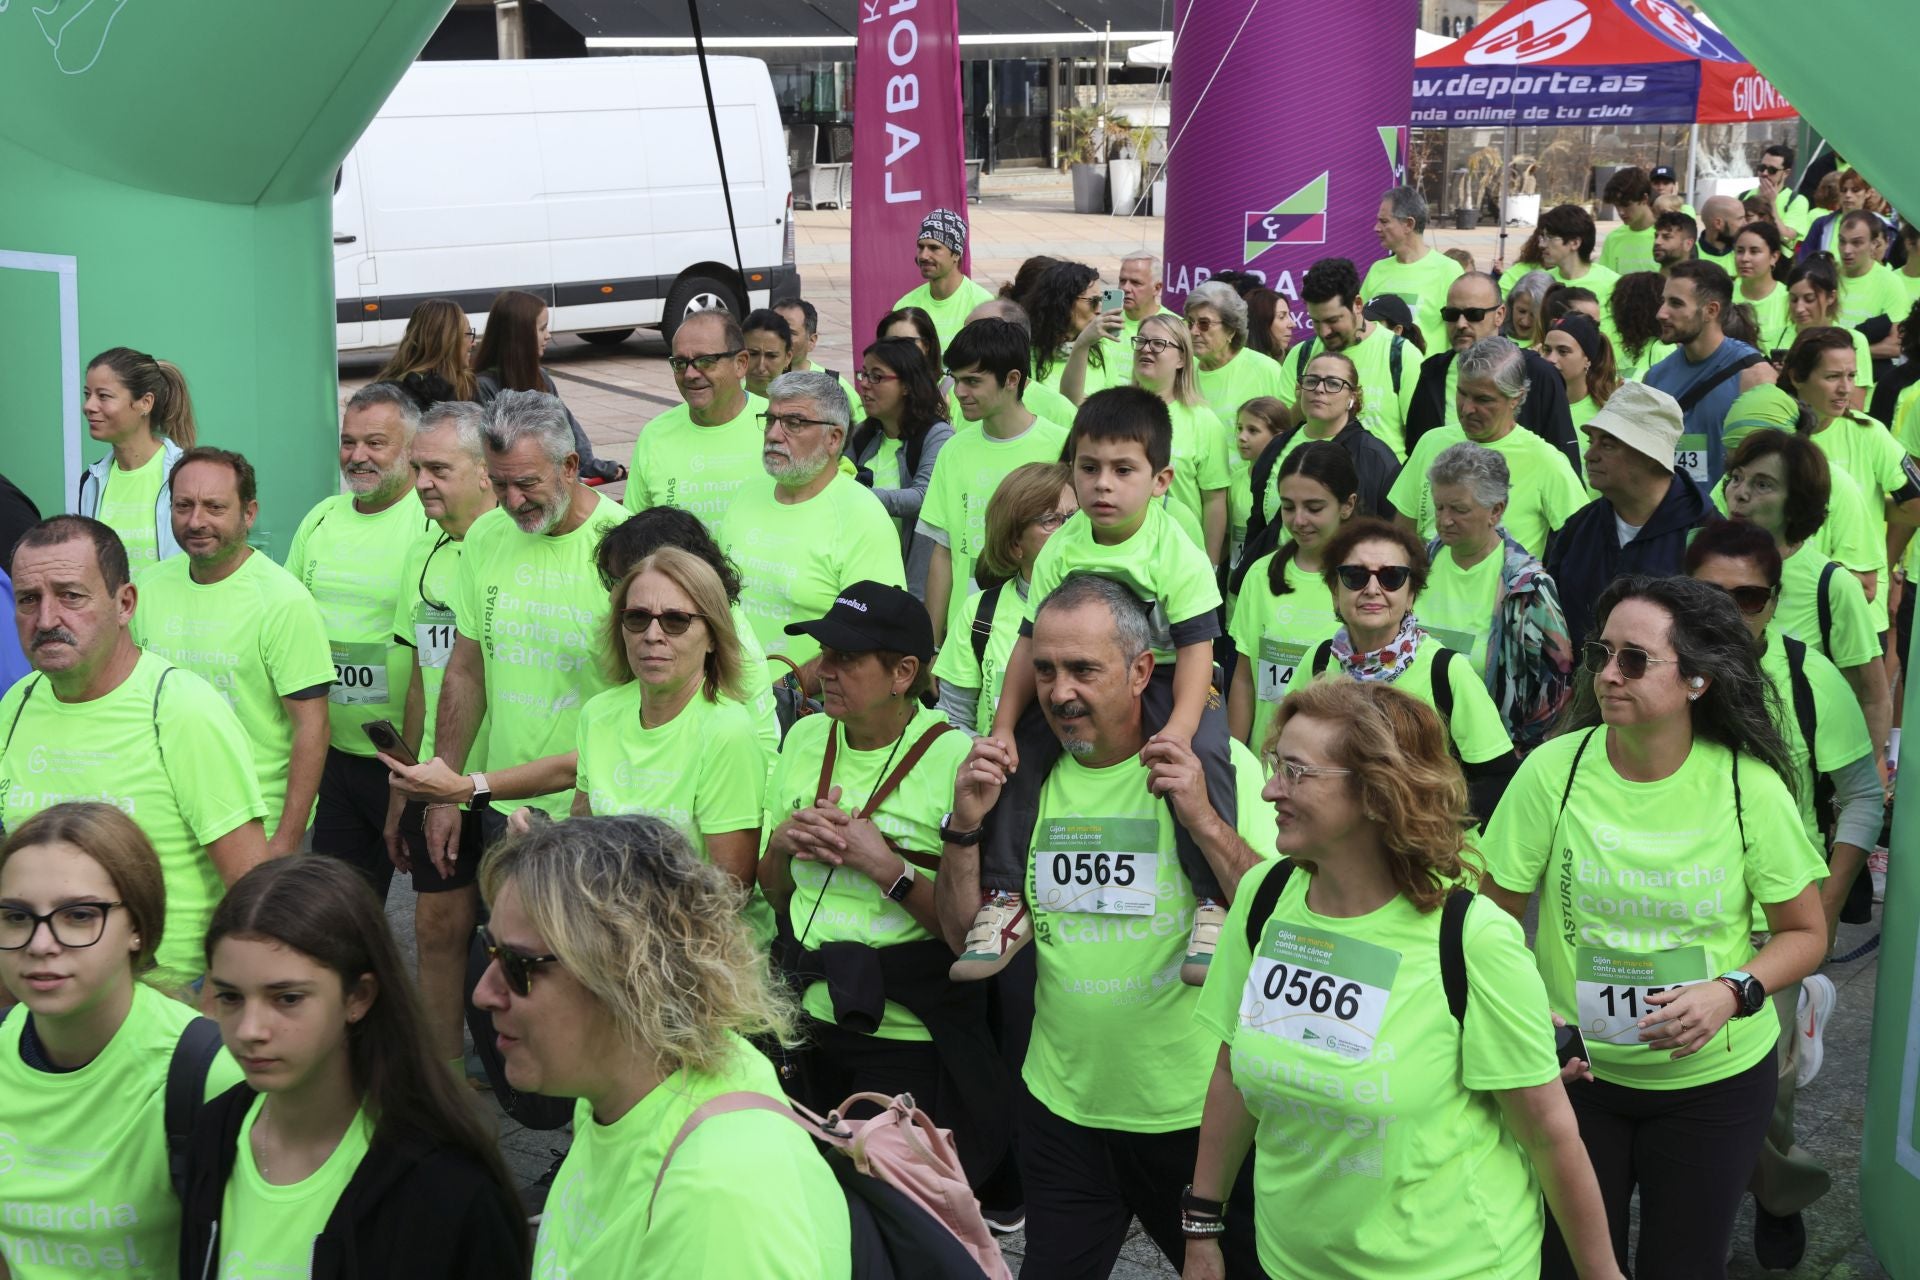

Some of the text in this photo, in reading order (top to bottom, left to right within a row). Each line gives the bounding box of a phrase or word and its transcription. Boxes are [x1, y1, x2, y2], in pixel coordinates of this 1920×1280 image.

[1454, 106, 1517, 121] online
[1523, 106, 1549, 119] de
[1556, 105, 1581, 118] tu
[1588, 105, 1633, 117] club
[1674, 452, 1698, 467] 43
[499, 592, 593, 625] En marcha
[428, 625, 457, 649] 11
[495, 618, 560, 647] contra
[1053, 853, 1135, 886] 0565
[1579, 860, 1727, 888] En marcha
[1561, 848, 1577, 947] ASTURIAS
[1578, 889, 1724, 919] contra el
[1275, 940, 1332, 959] contra el cáncer
[1278, 930, 1296, 941] Gijón
[1592, 956, 1611, 965] Gijón
[1592, 965, 1616, 973] contra
[1627, 967, 1654, 975] cáncer
[1063, 976, 1148, 995] LABORAL
[1263, 964, 1362, 1021] 0566
[1233, 1052, 1395, 1104] contra el
[4, 1200, 138, 1230] marcha
[97, 1235, 144, 1269] el
